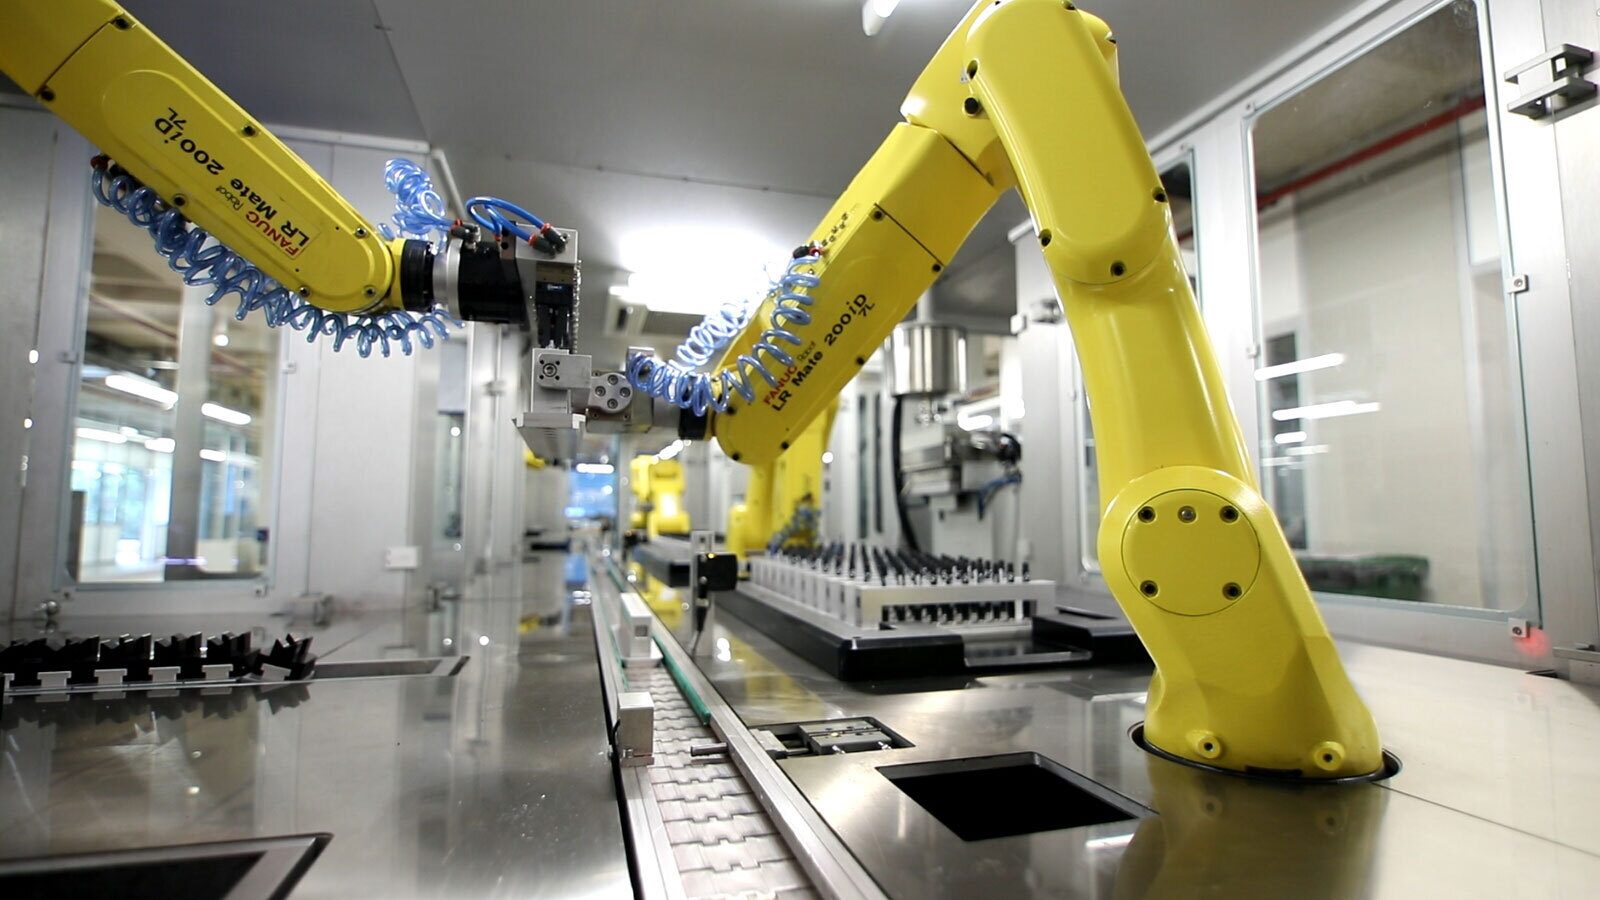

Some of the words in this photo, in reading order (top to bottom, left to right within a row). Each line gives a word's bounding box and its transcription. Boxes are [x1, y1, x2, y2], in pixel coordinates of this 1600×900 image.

[167, 107, 187, 130] 7L
[215, 185, 244, 211] Robot
[230, 178, 278, 220] Mate
[246, 210, 300, 256] FANUC
[280, 220, 310, 248] LR
[858, 302, 875, 317] 7L
[763, 366, 798, 405] FANUC
[772, 390, 792, 411] LR
[791, 351, 823, 386] Mate
